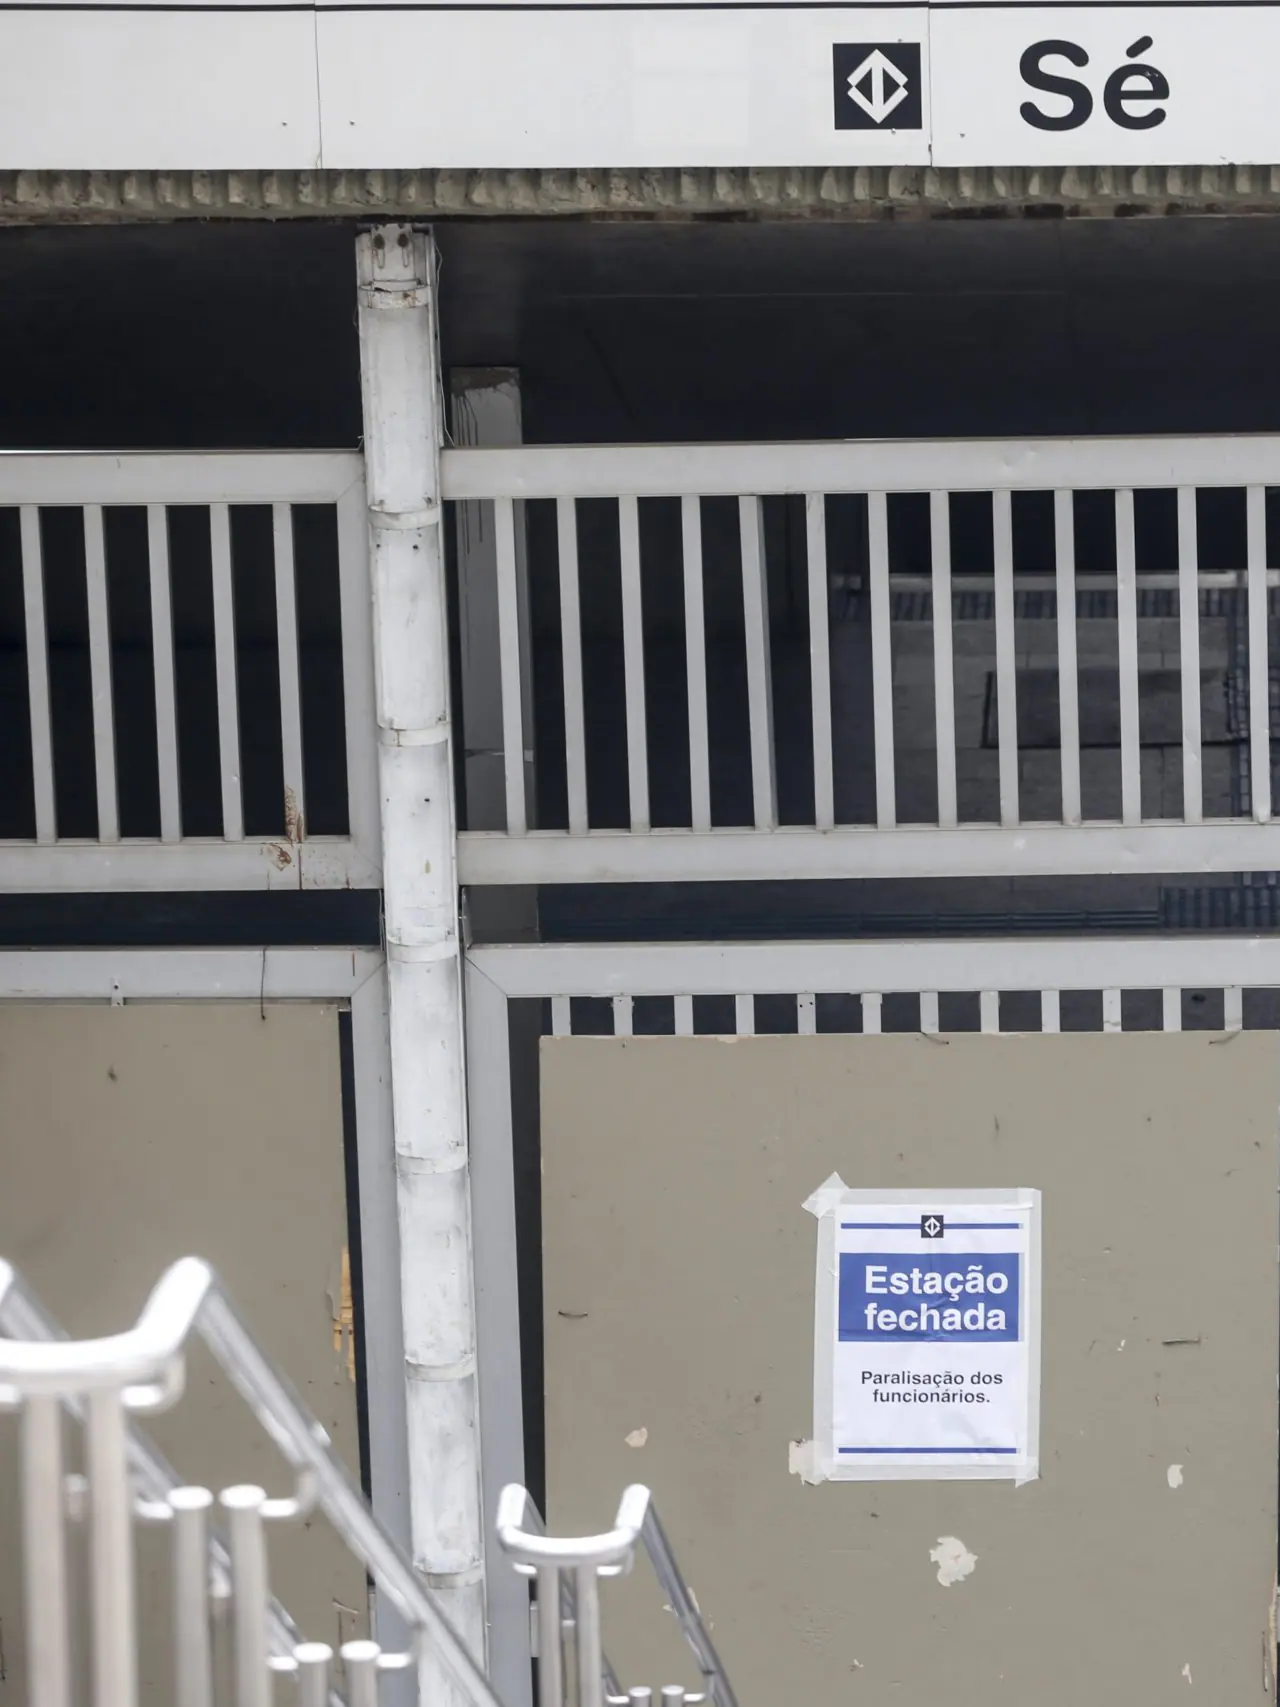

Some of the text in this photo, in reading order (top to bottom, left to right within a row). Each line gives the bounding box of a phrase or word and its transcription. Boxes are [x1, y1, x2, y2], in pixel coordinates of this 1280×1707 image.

[1019, 35, 1170, 132] Sé
[865, 1264, 1009, 1301] Estação
[864, 1302, 1007, 1331] fechada
[861, 1370, 1003, 1388] Paralisação dos
[873, 1388, 991, 1404] funcionários.
